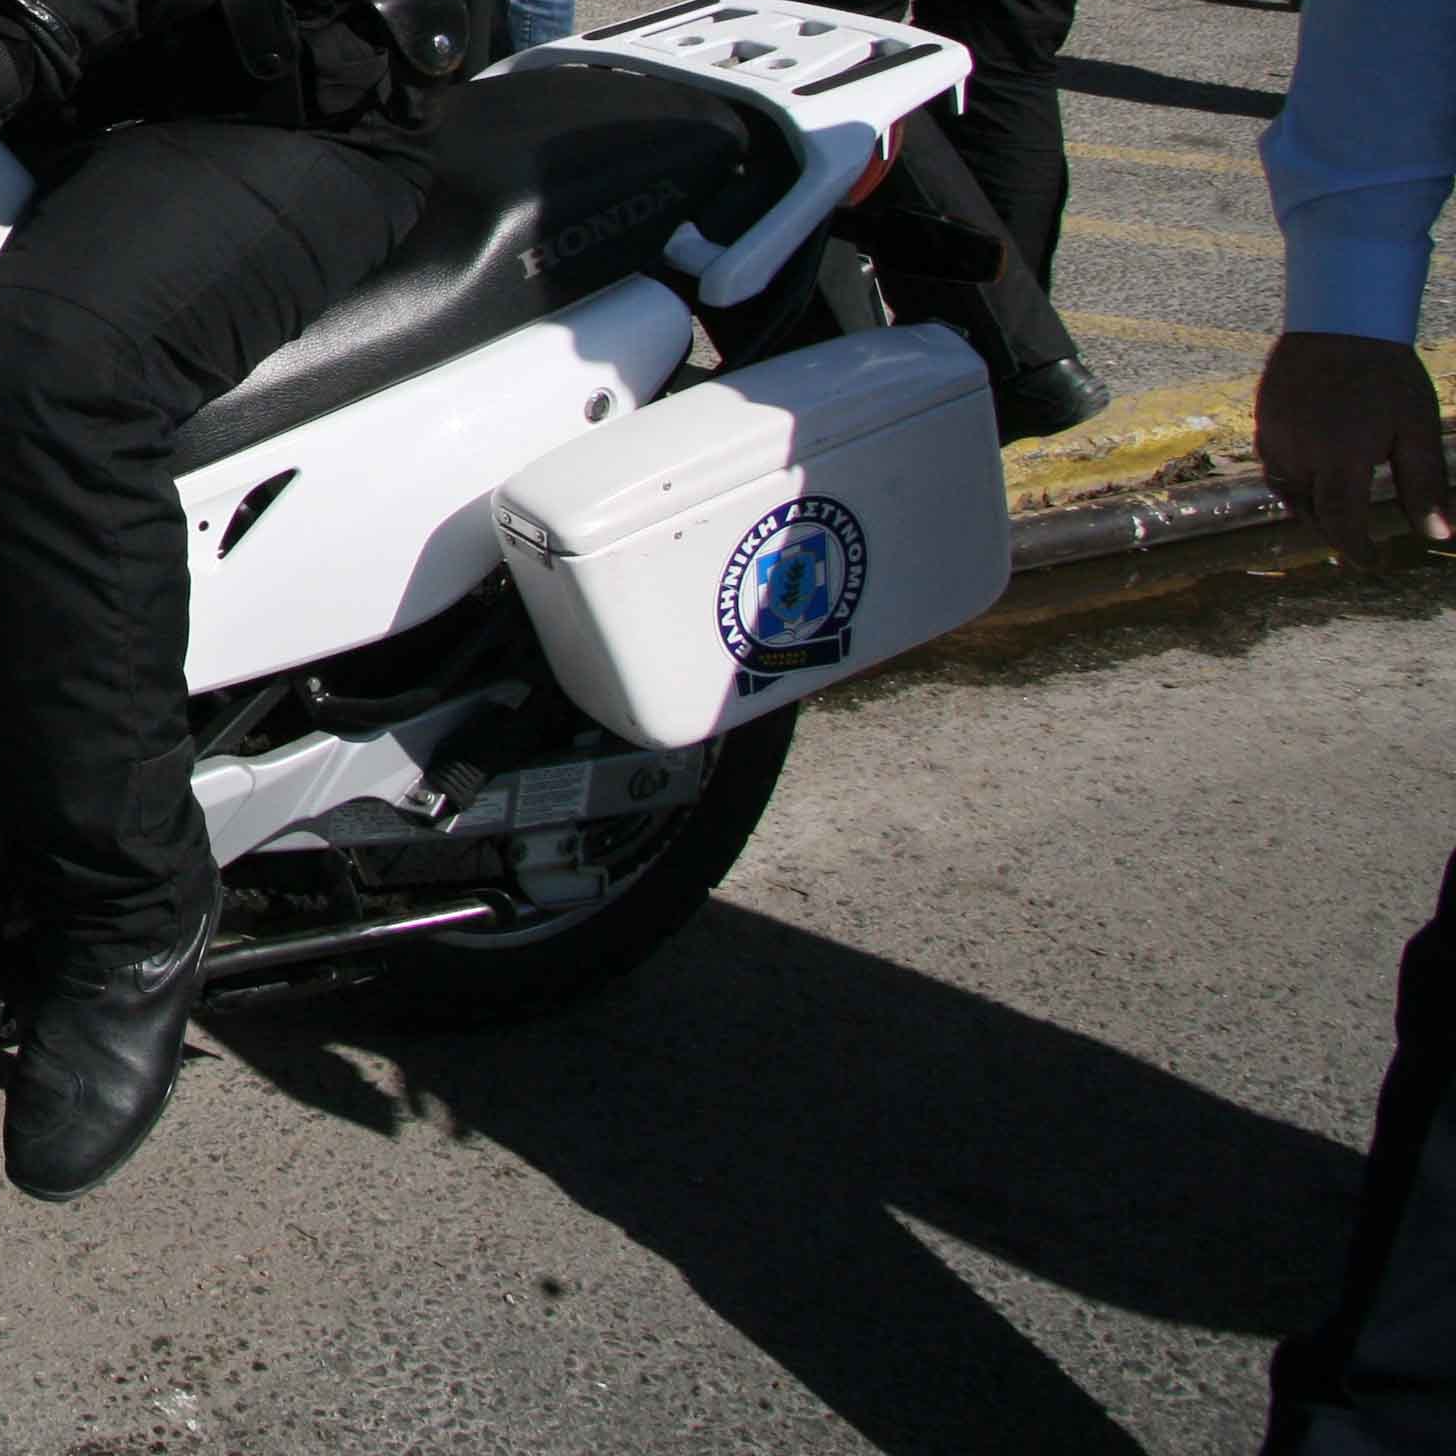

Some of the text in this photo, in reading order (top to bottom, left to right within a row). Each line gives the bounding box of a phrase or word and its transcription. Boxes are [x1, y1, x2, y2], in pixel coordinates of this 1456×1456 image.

[517, 181, 688, 279] HONDA
[719, 501, 865, 658] ΕΛΛΗΝΙΚΗ ΑΣΤΥΝΟΜΙΑ
